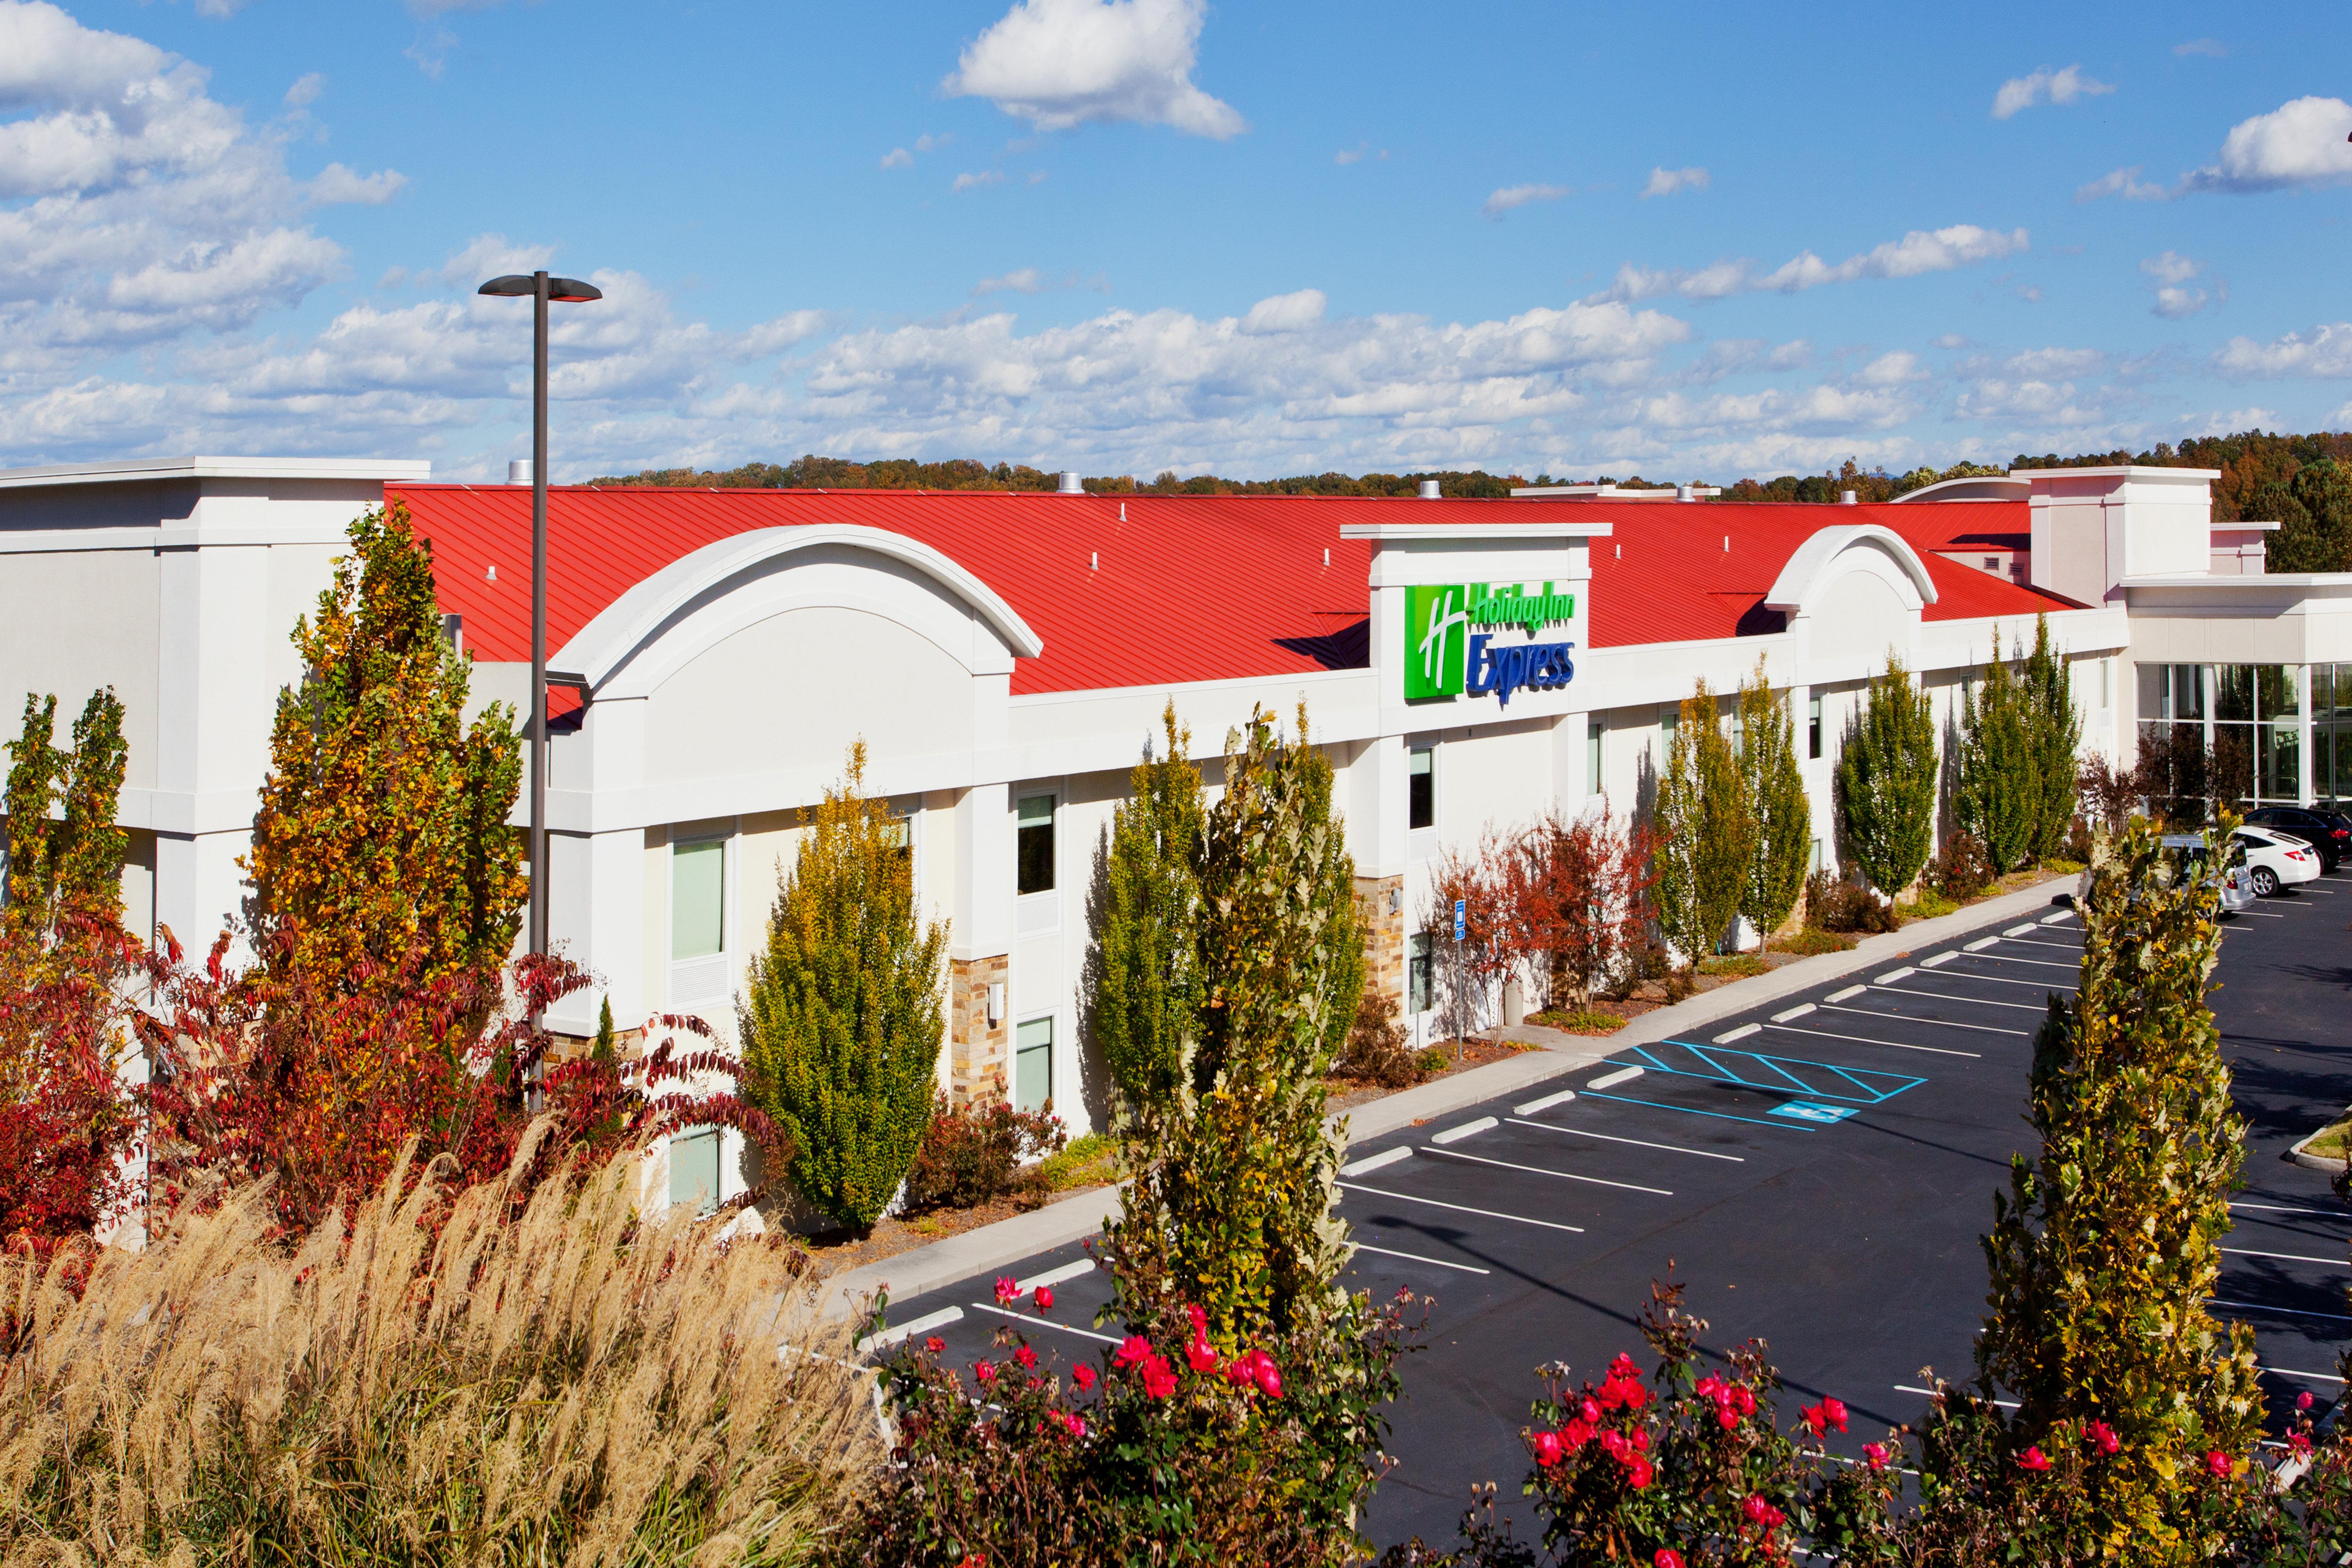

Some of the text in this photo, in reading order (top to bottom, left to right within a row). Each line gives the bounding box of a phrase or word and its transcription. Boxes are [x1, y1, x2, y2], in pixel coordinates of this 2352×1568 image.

[1466, 581, 1575, 632] Holiday Inn
[1466, 634, 1575, 705] Express
